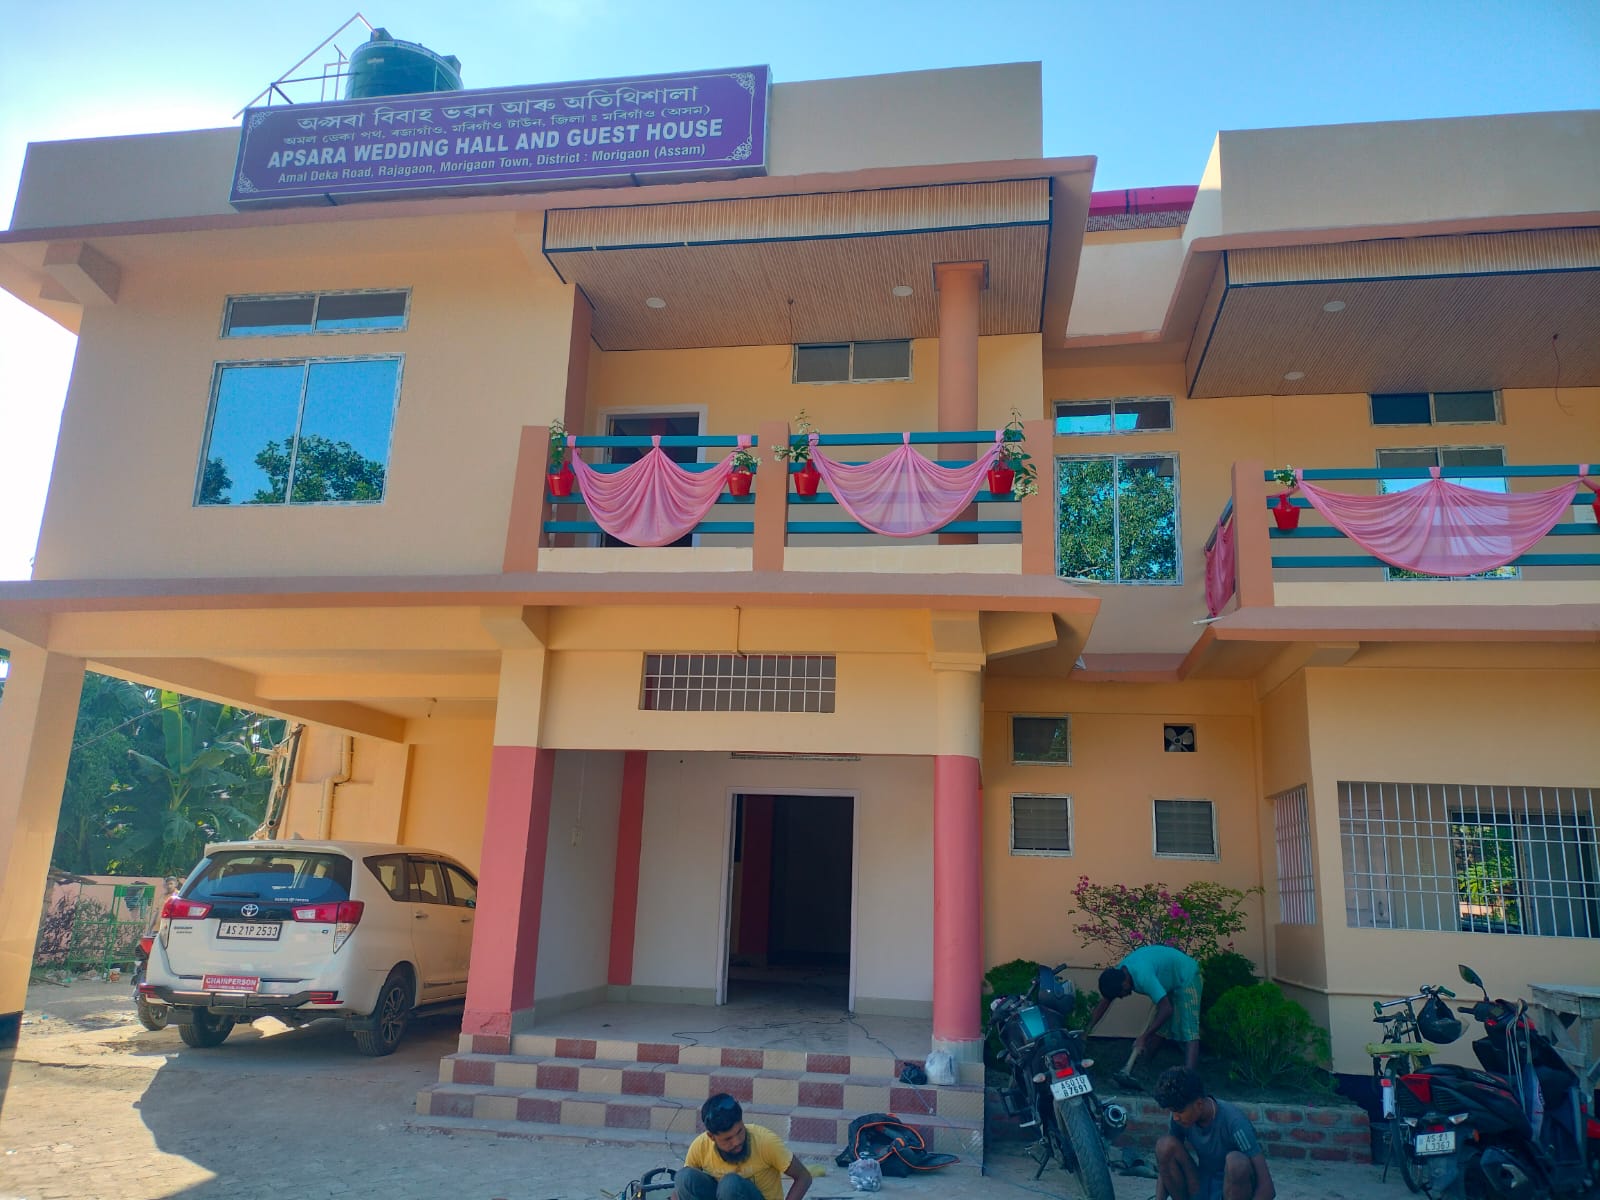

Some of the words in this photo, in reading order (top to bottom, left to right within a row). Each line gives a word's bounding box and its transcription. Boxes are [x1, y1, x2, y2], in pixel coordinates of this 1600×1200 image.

[372, 106, 434, 126] বিবাহ
[500, 99, 556, 114] আৰু
[562, 86, 699, 110] অতিথিশালা
[267, 147, 347, 168] APSARA
[354, 139, 449, 162] WEDDING
[455, 135, 509, 155] HALL
[515, 131, 560, 150] AND
[567, 124, 640, 146] GUEST
[646, 119, 723, 140] HOUSE
[278, 171, 307, 183] Amal
[310, 170, 338, 181] Deka
[378, 164, 436, 177] Rajagaon,
[440, 160, 495, 172] Morigaon
[500, 157, 532, 168] Town,
[537, 152, 580, 165] District
[592, 149, 650, 162] Morigaon
[654, 144, 706, 159] (Assam)
